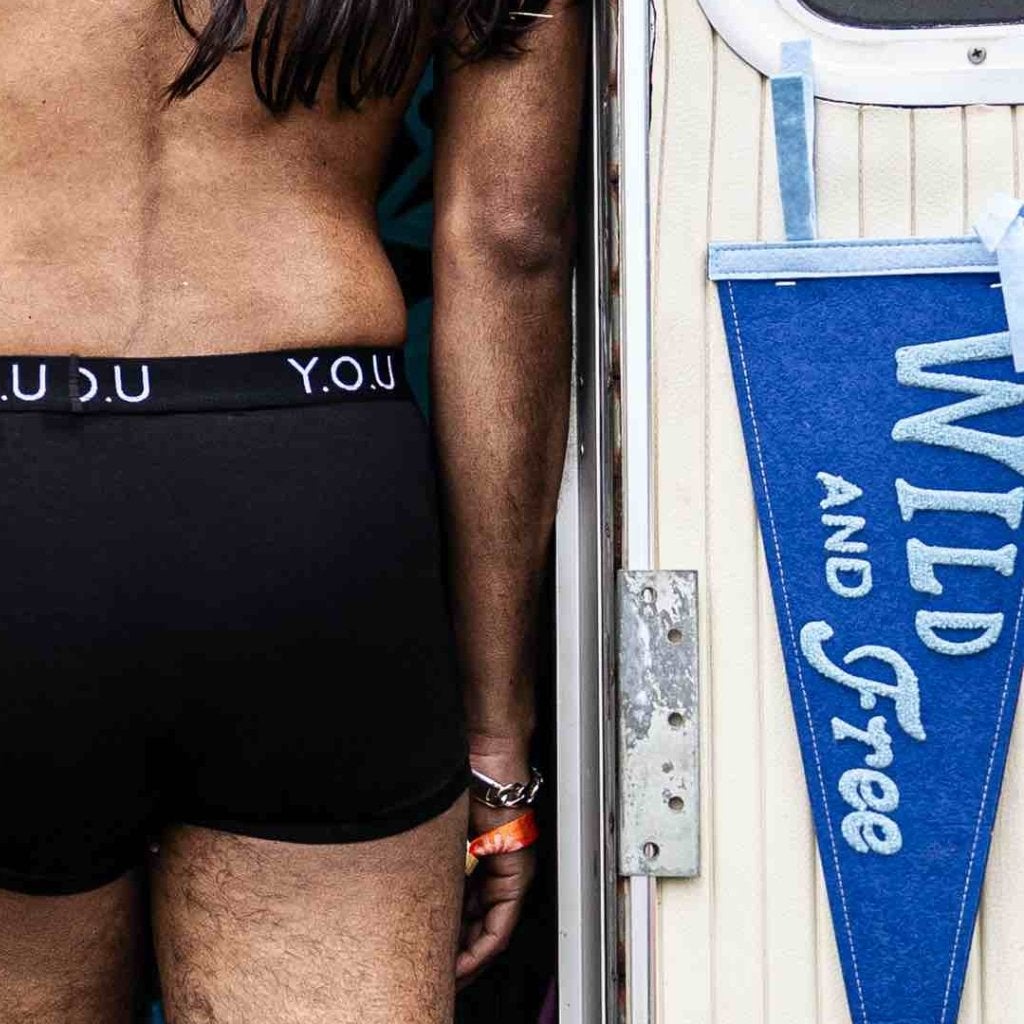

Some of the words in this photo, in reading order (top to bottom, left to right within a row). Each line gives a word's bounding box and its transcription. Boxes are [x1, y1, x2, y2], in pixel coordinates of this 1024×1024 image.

[287, 354, 395, 394] Y.O.U
[816, 471, 873, 598] AND
[892, 331, 1024, 655] WILD
[800, 620, 927, 855] Free
